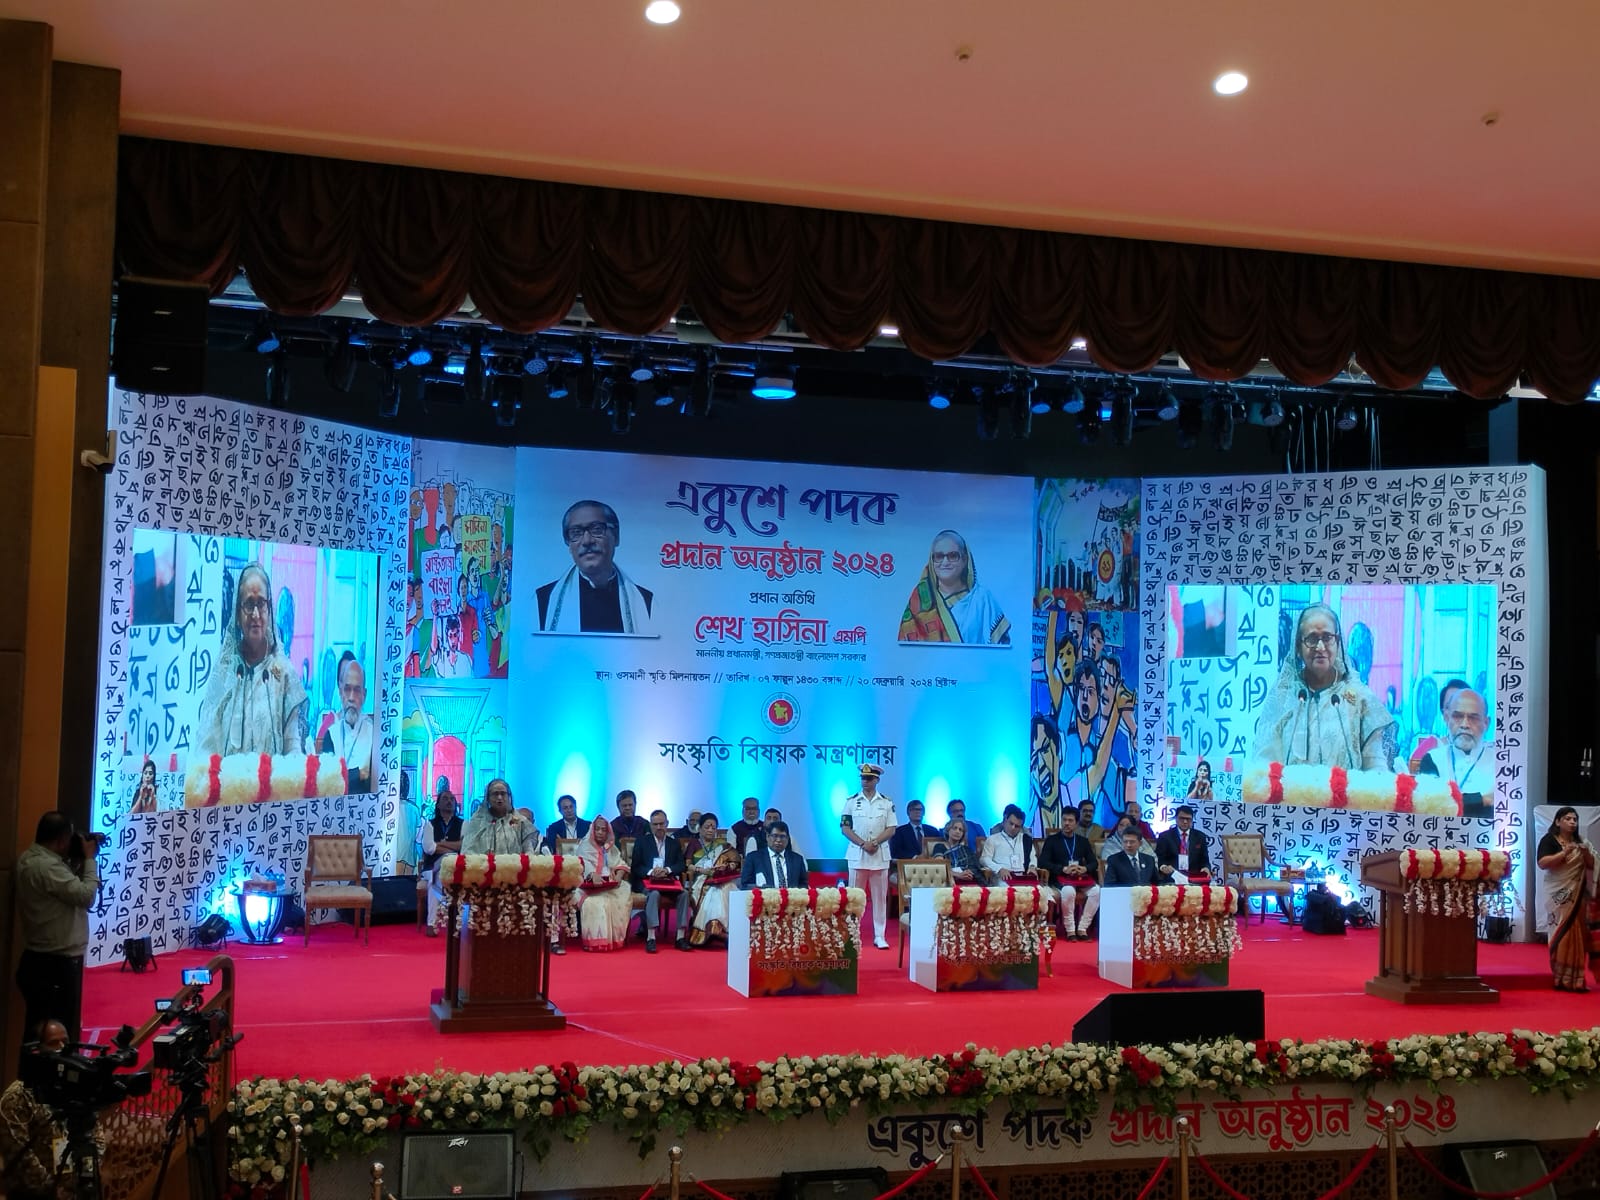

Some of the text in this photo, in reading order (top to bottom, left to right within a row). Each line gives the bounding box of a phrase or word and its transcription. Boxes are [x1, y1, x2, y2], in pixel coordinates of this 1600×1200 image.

[666, 481, 900, 537] একুশে পদক
[660, 540, 897, 580] প্রদান অনুষ্ঠান ২০২৪
[750, 589, 815, 605] প্রধান অতিথি
[694, 608, 867, 646] শেখ হাসিনা এমপি
[695, 648, 725, 660] মাননীয়
[805, 651, 840, 663] বাংলাদেশ
[841, 652, 867, 663] সরকার
[616, 669, 646, 682] ওসমানী
[649, 670, 667, 684] স্মৃতি
[669, 671, 711, 683] মিলনায়তন
[726, 671, 750, 683] তারিখ
[758, 675, 770, 684] ০৭
[796, 675, 819, 685] ১৪৩০
[821, 675, 844, 686] বঙ্গাব্দ
[857, 677, 869, 687] ২০
[910, 677, 932, 688] ২০২৪
[657, 735, 898, 774] সংস্কৃতি বিষয়ক মন্ত্রণালয়
[867, 1109, 987, 1168] একুশে
[1002, 1108, 1094, 1147] পদক
[1213, 1086, 1355, 1151] অনুষ্ঠান
[1365, 1094, 1458, 1133] ২০২৪
